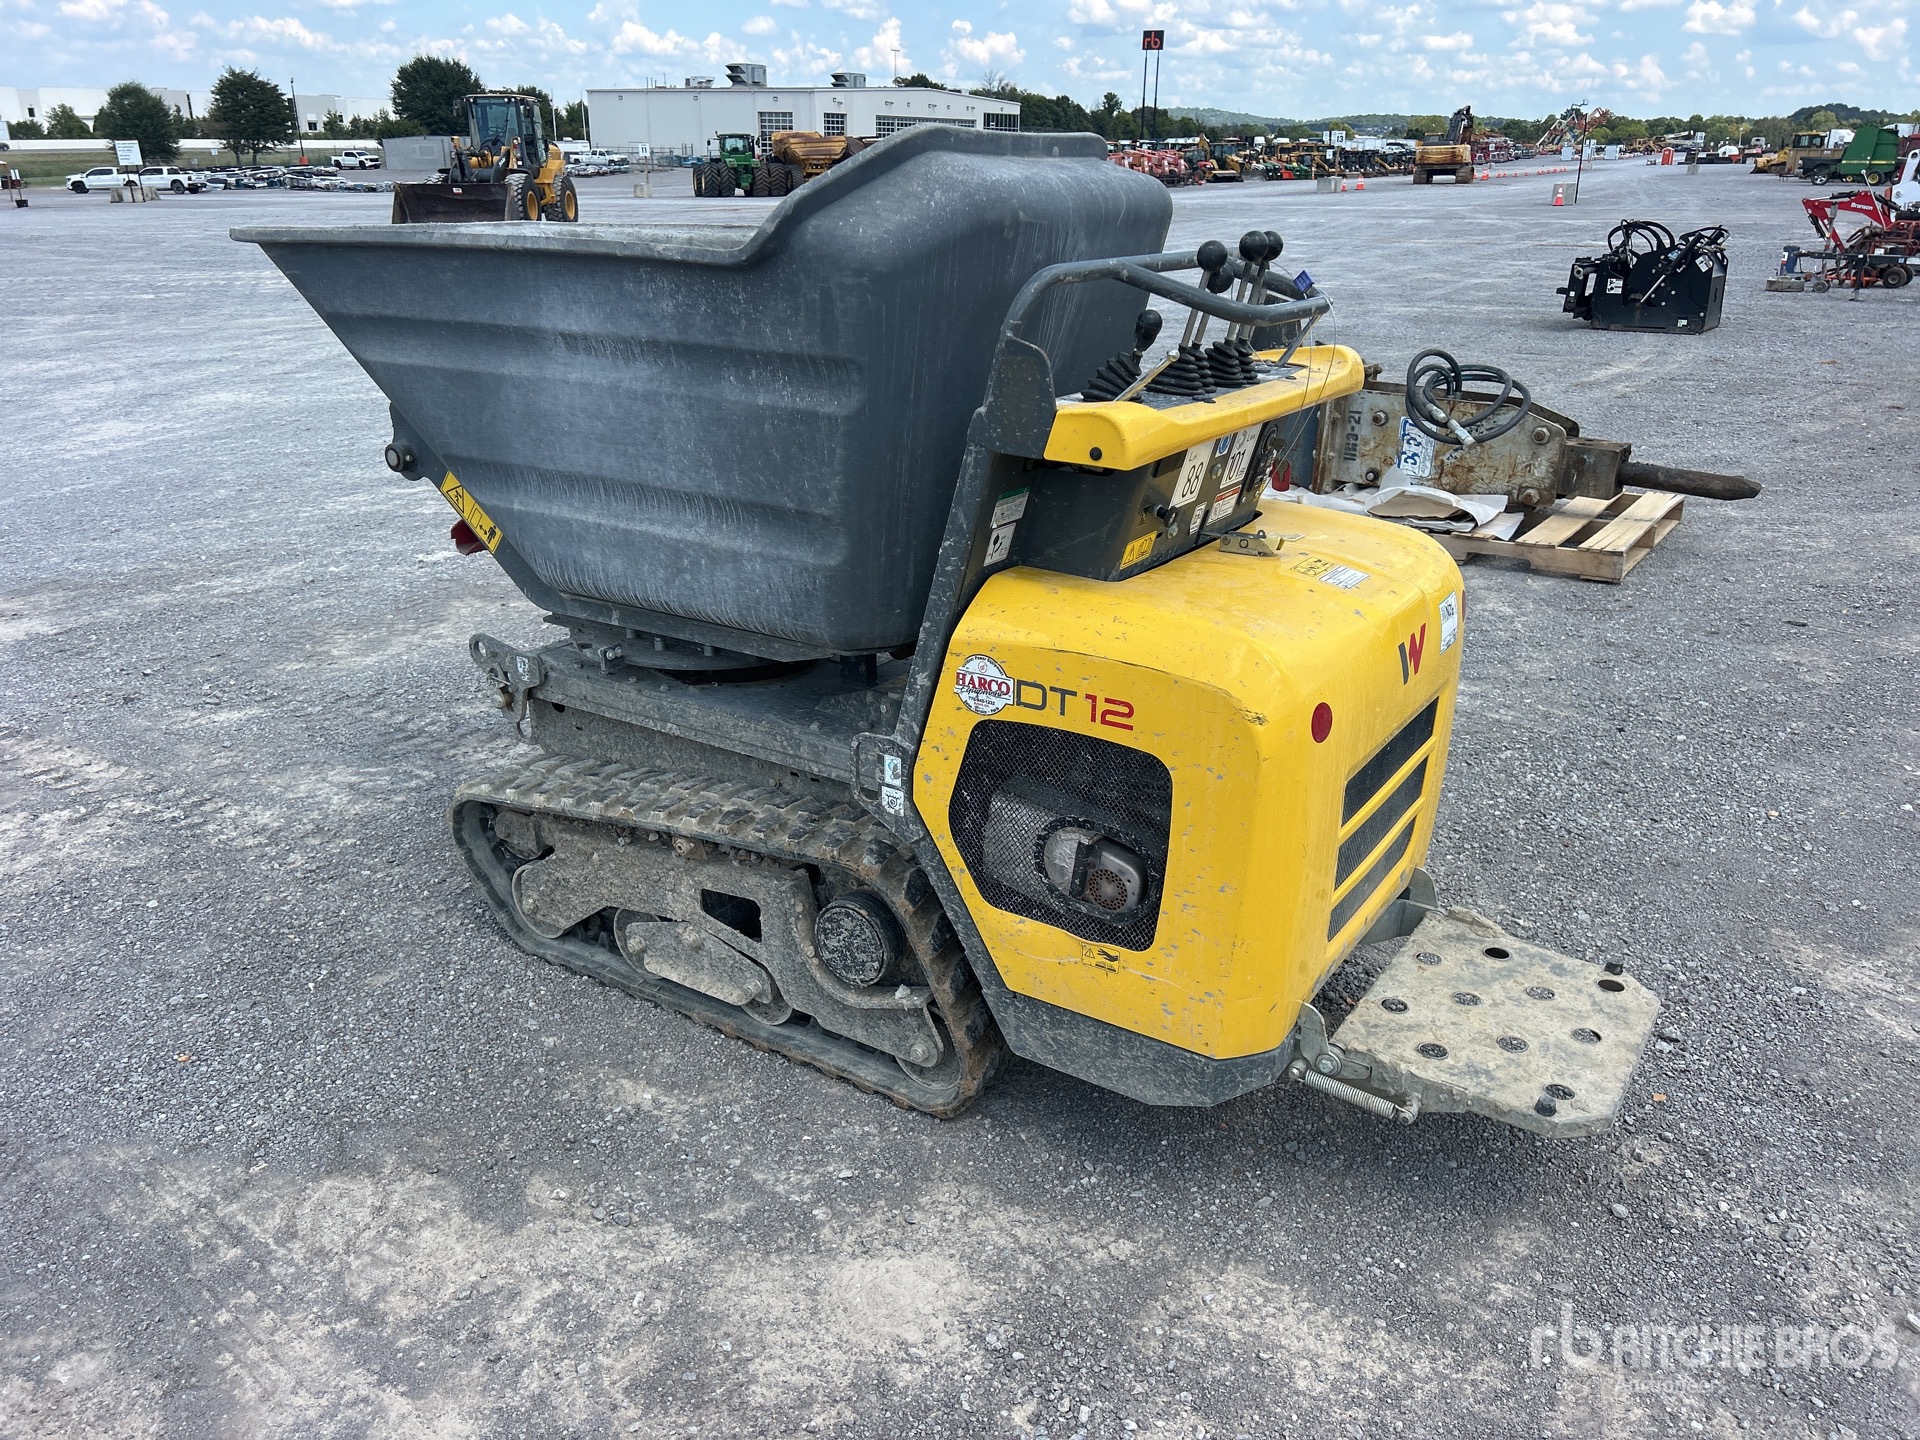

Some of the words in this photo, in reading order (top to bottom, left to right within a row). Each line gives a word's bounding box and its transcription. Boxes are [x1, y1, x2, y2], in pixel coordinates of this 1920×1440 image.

[1144, 31, 1160, 49] rb
[1336, 135, 1343, 143] 13
[1850, 202, 1873, 211] Branson
[1225, 448, 1247, 482] 101
[1181, 461, 1204, 499] 88
[956, 671, 1011, 696] HARCO
